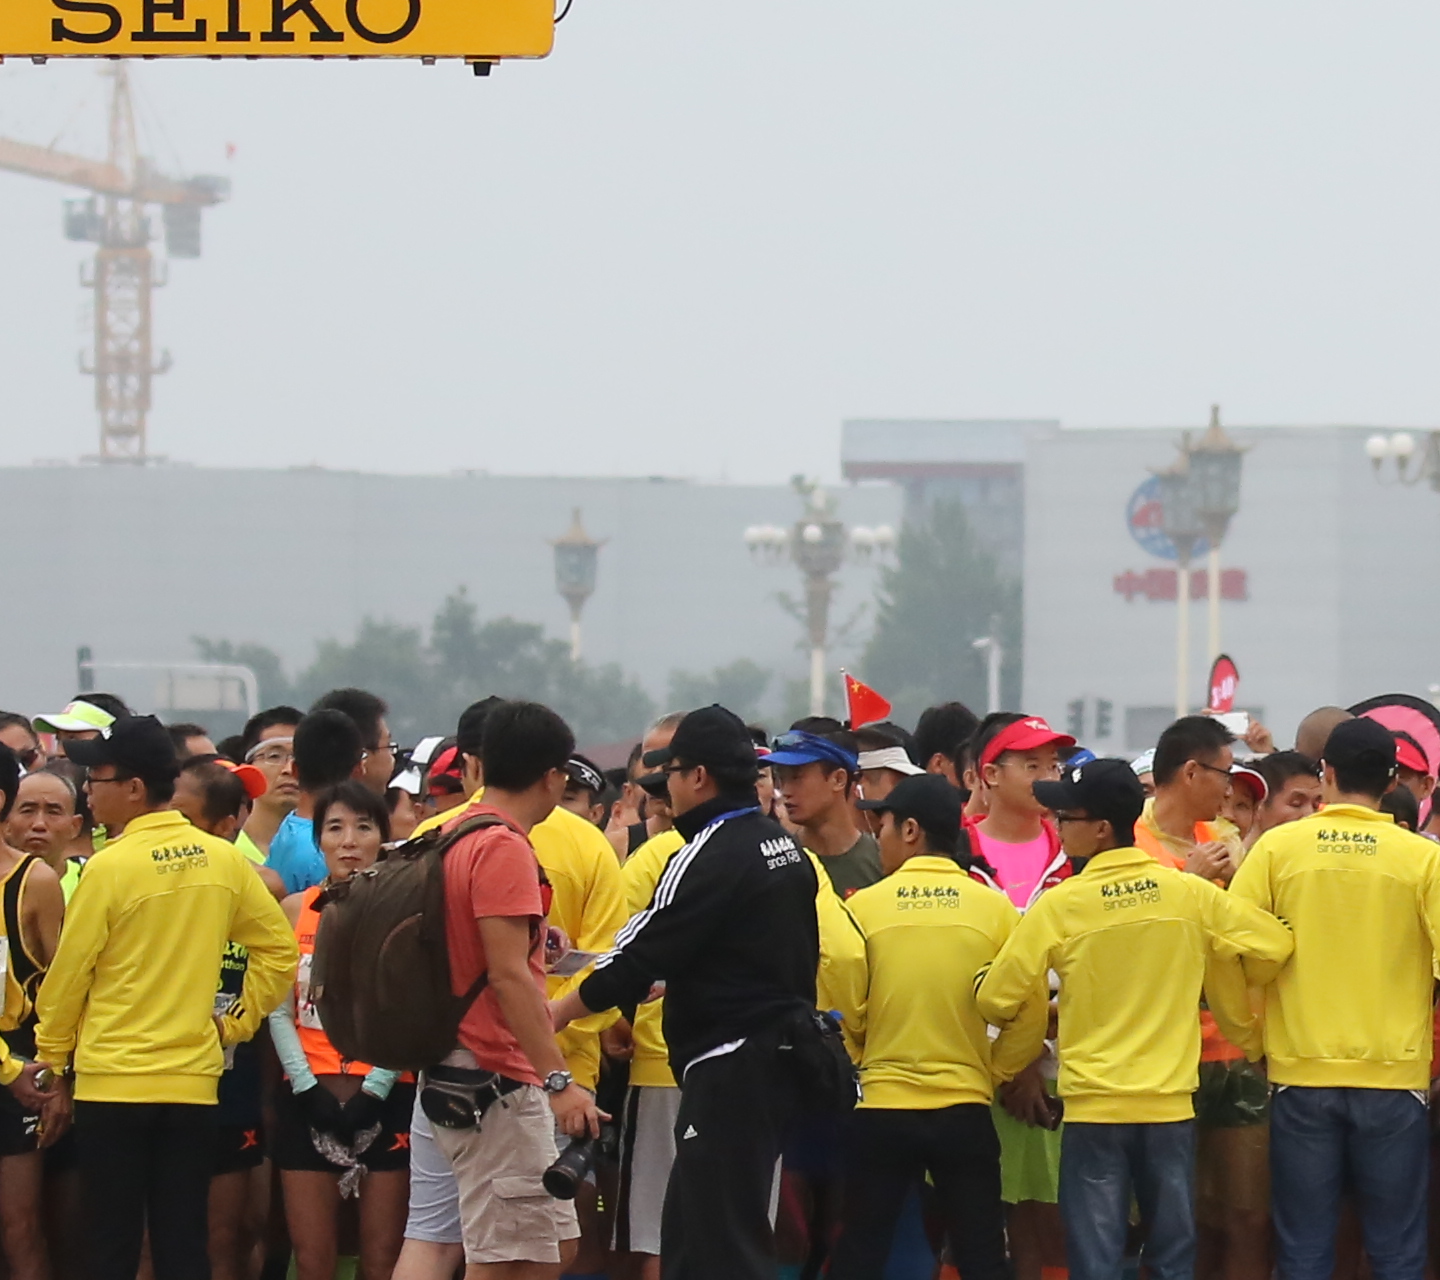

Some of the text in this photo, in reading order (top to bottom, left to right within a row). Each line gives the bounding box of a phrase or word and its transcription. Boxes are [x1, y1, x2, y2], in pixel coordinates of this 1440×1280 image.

[1316, 842, 1377, 856] since 1981
[156, 856, 209, 876] since 1981
[766, 849, 802, 871] since 1981
[896, 897, 960, 911] since 1981
[1103, 889, 1162, 912] since 1981
